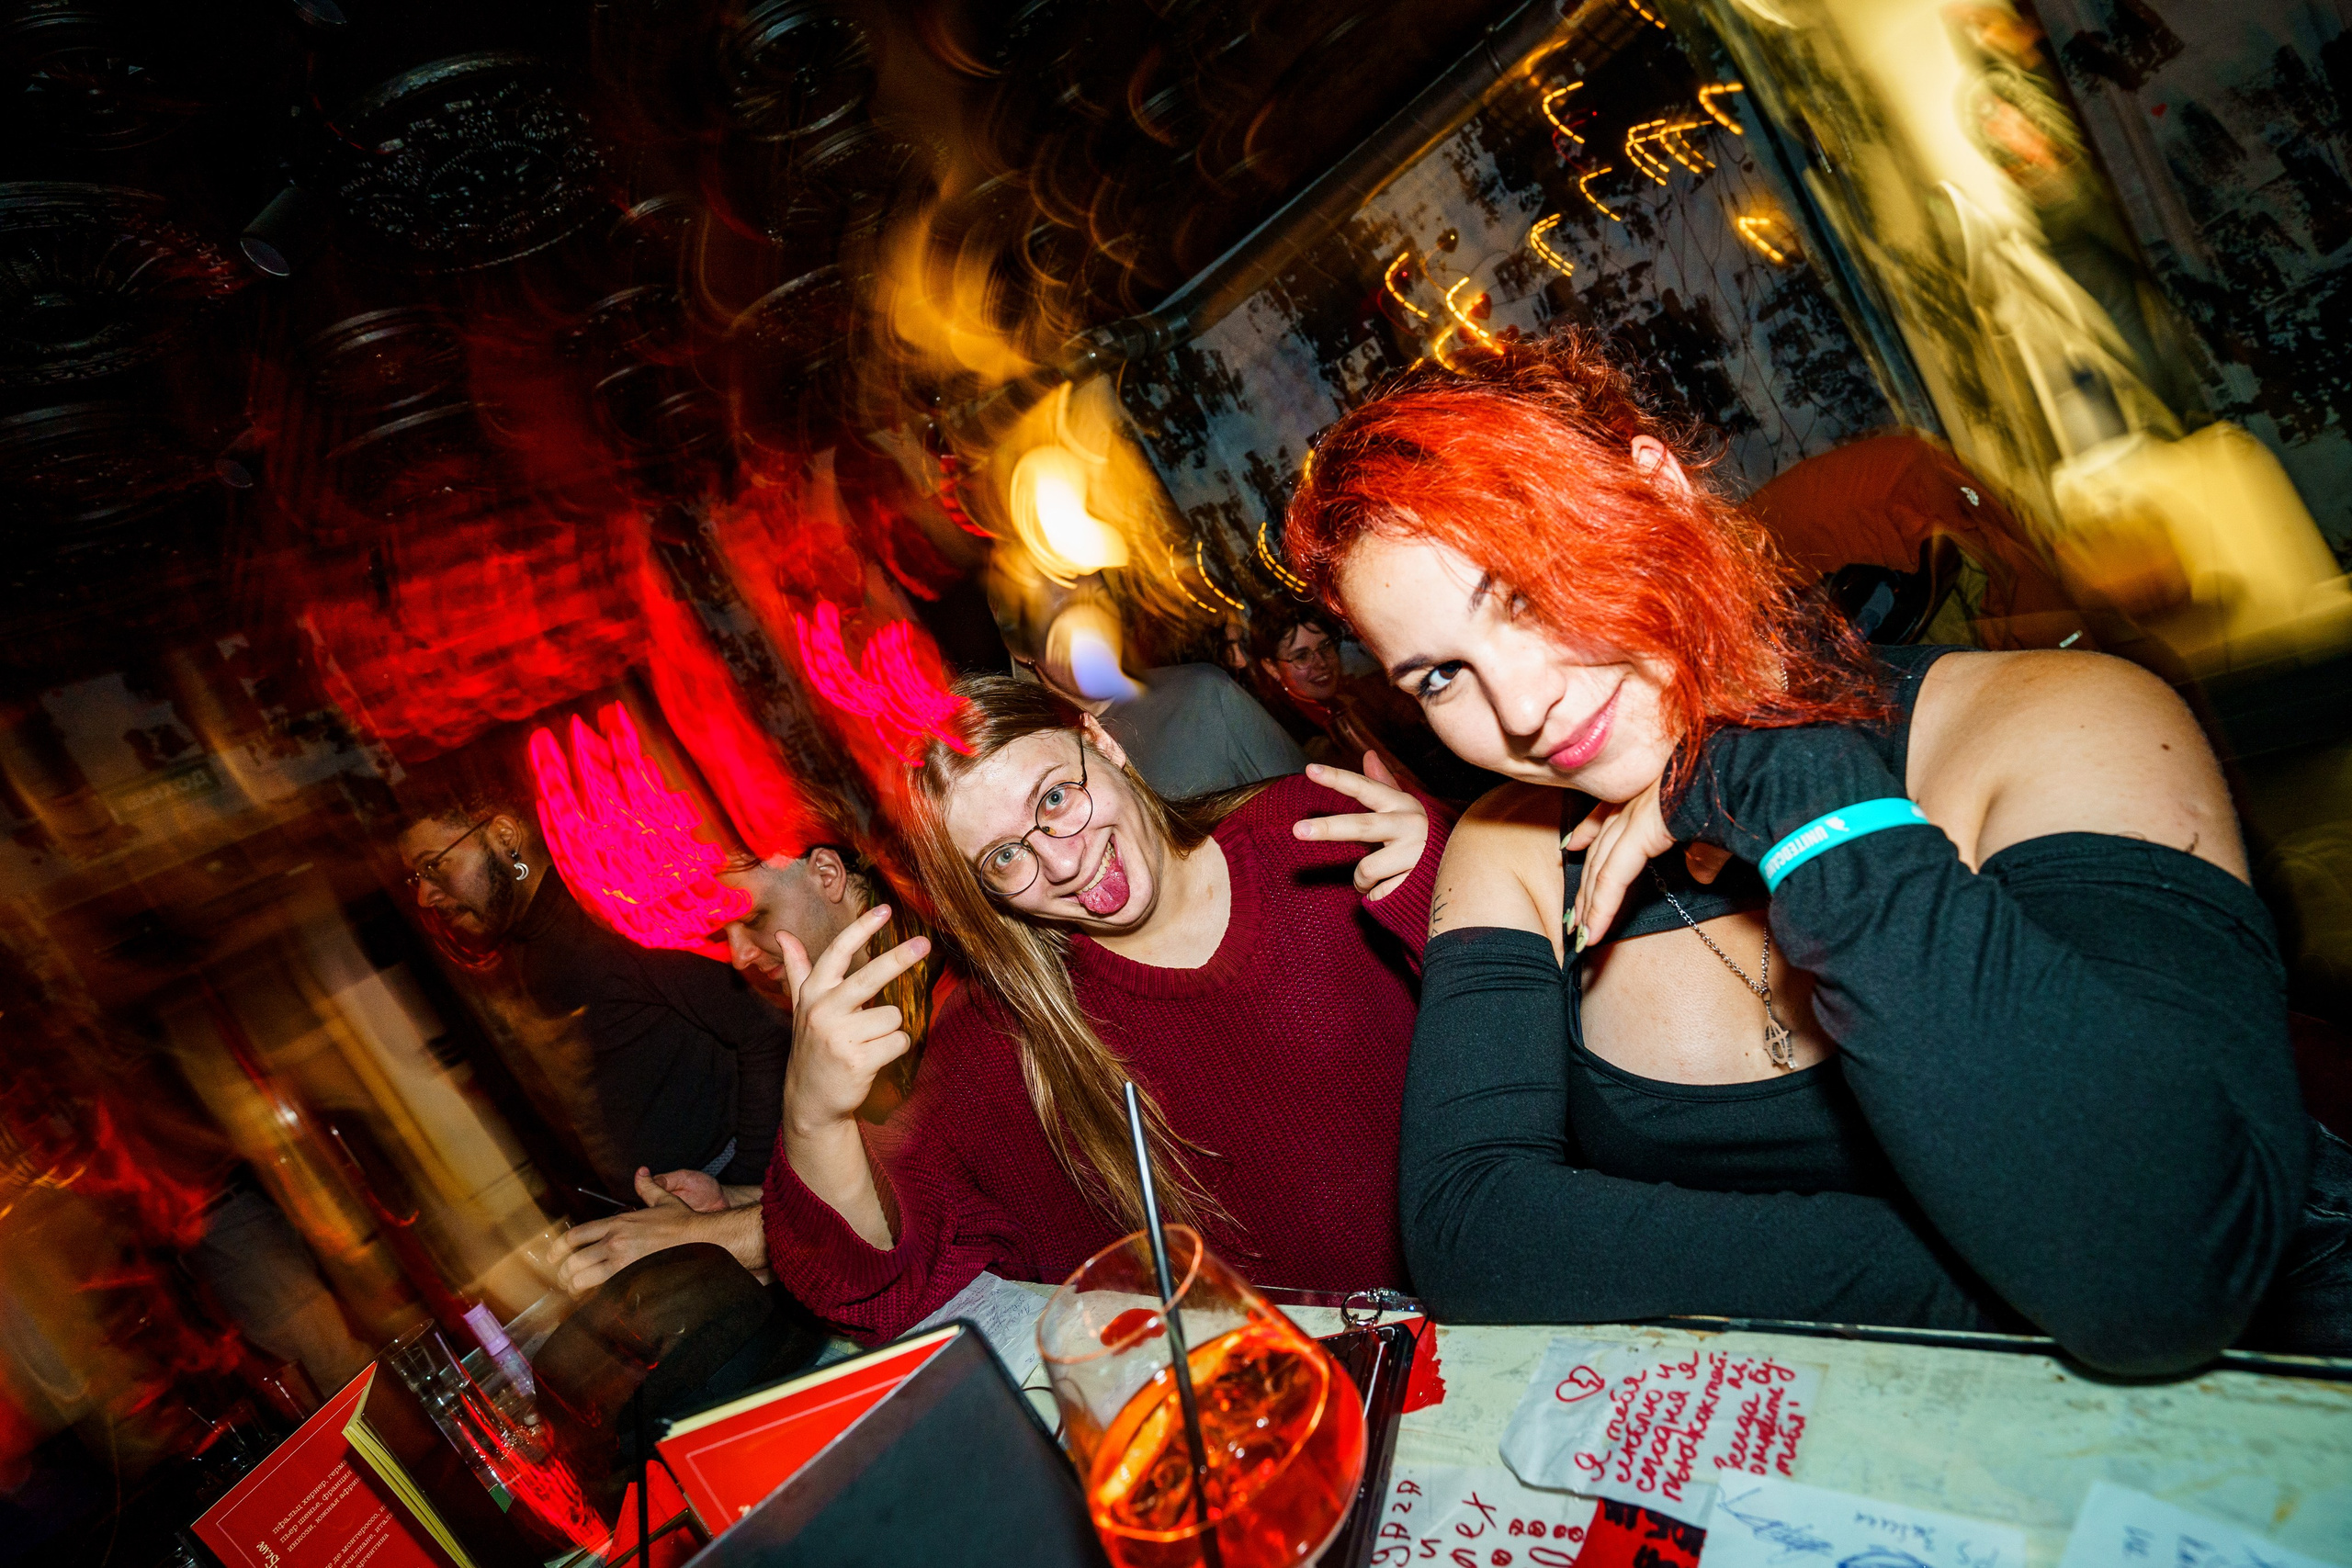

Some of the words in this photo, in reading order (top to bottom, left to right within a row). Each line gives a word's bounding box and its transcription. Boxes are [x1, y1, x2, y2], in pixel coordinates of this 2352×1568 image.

[1678, 1350, 1700, 1380] я
[1574, 1449, 1611, 1482] Я
[1607, 1370, 1647, 1441] тебя
[1616, 1389, 1664, 1483] люблю
[1657, 1363, 1677, 1379] и
[272, 1504, 304, 1535] пфальц
[301, 1480, 329, 1506] хернер,
[328, 1460, 347, 1480] герма
[279, 1524, 299, 1544] пьер
[298, 1501, 323, 1526] шенье,
[322, 1470, 353, 1501] франция
[287, 1524, 317, 1553] инкози,
[315, 1498, 340, 1524] южная
[341, 1533, 377, 1568] ичилиане,
[375, 1511, 393, 1533] итал
[342, 1513, 380, 1554] монтероссо,
